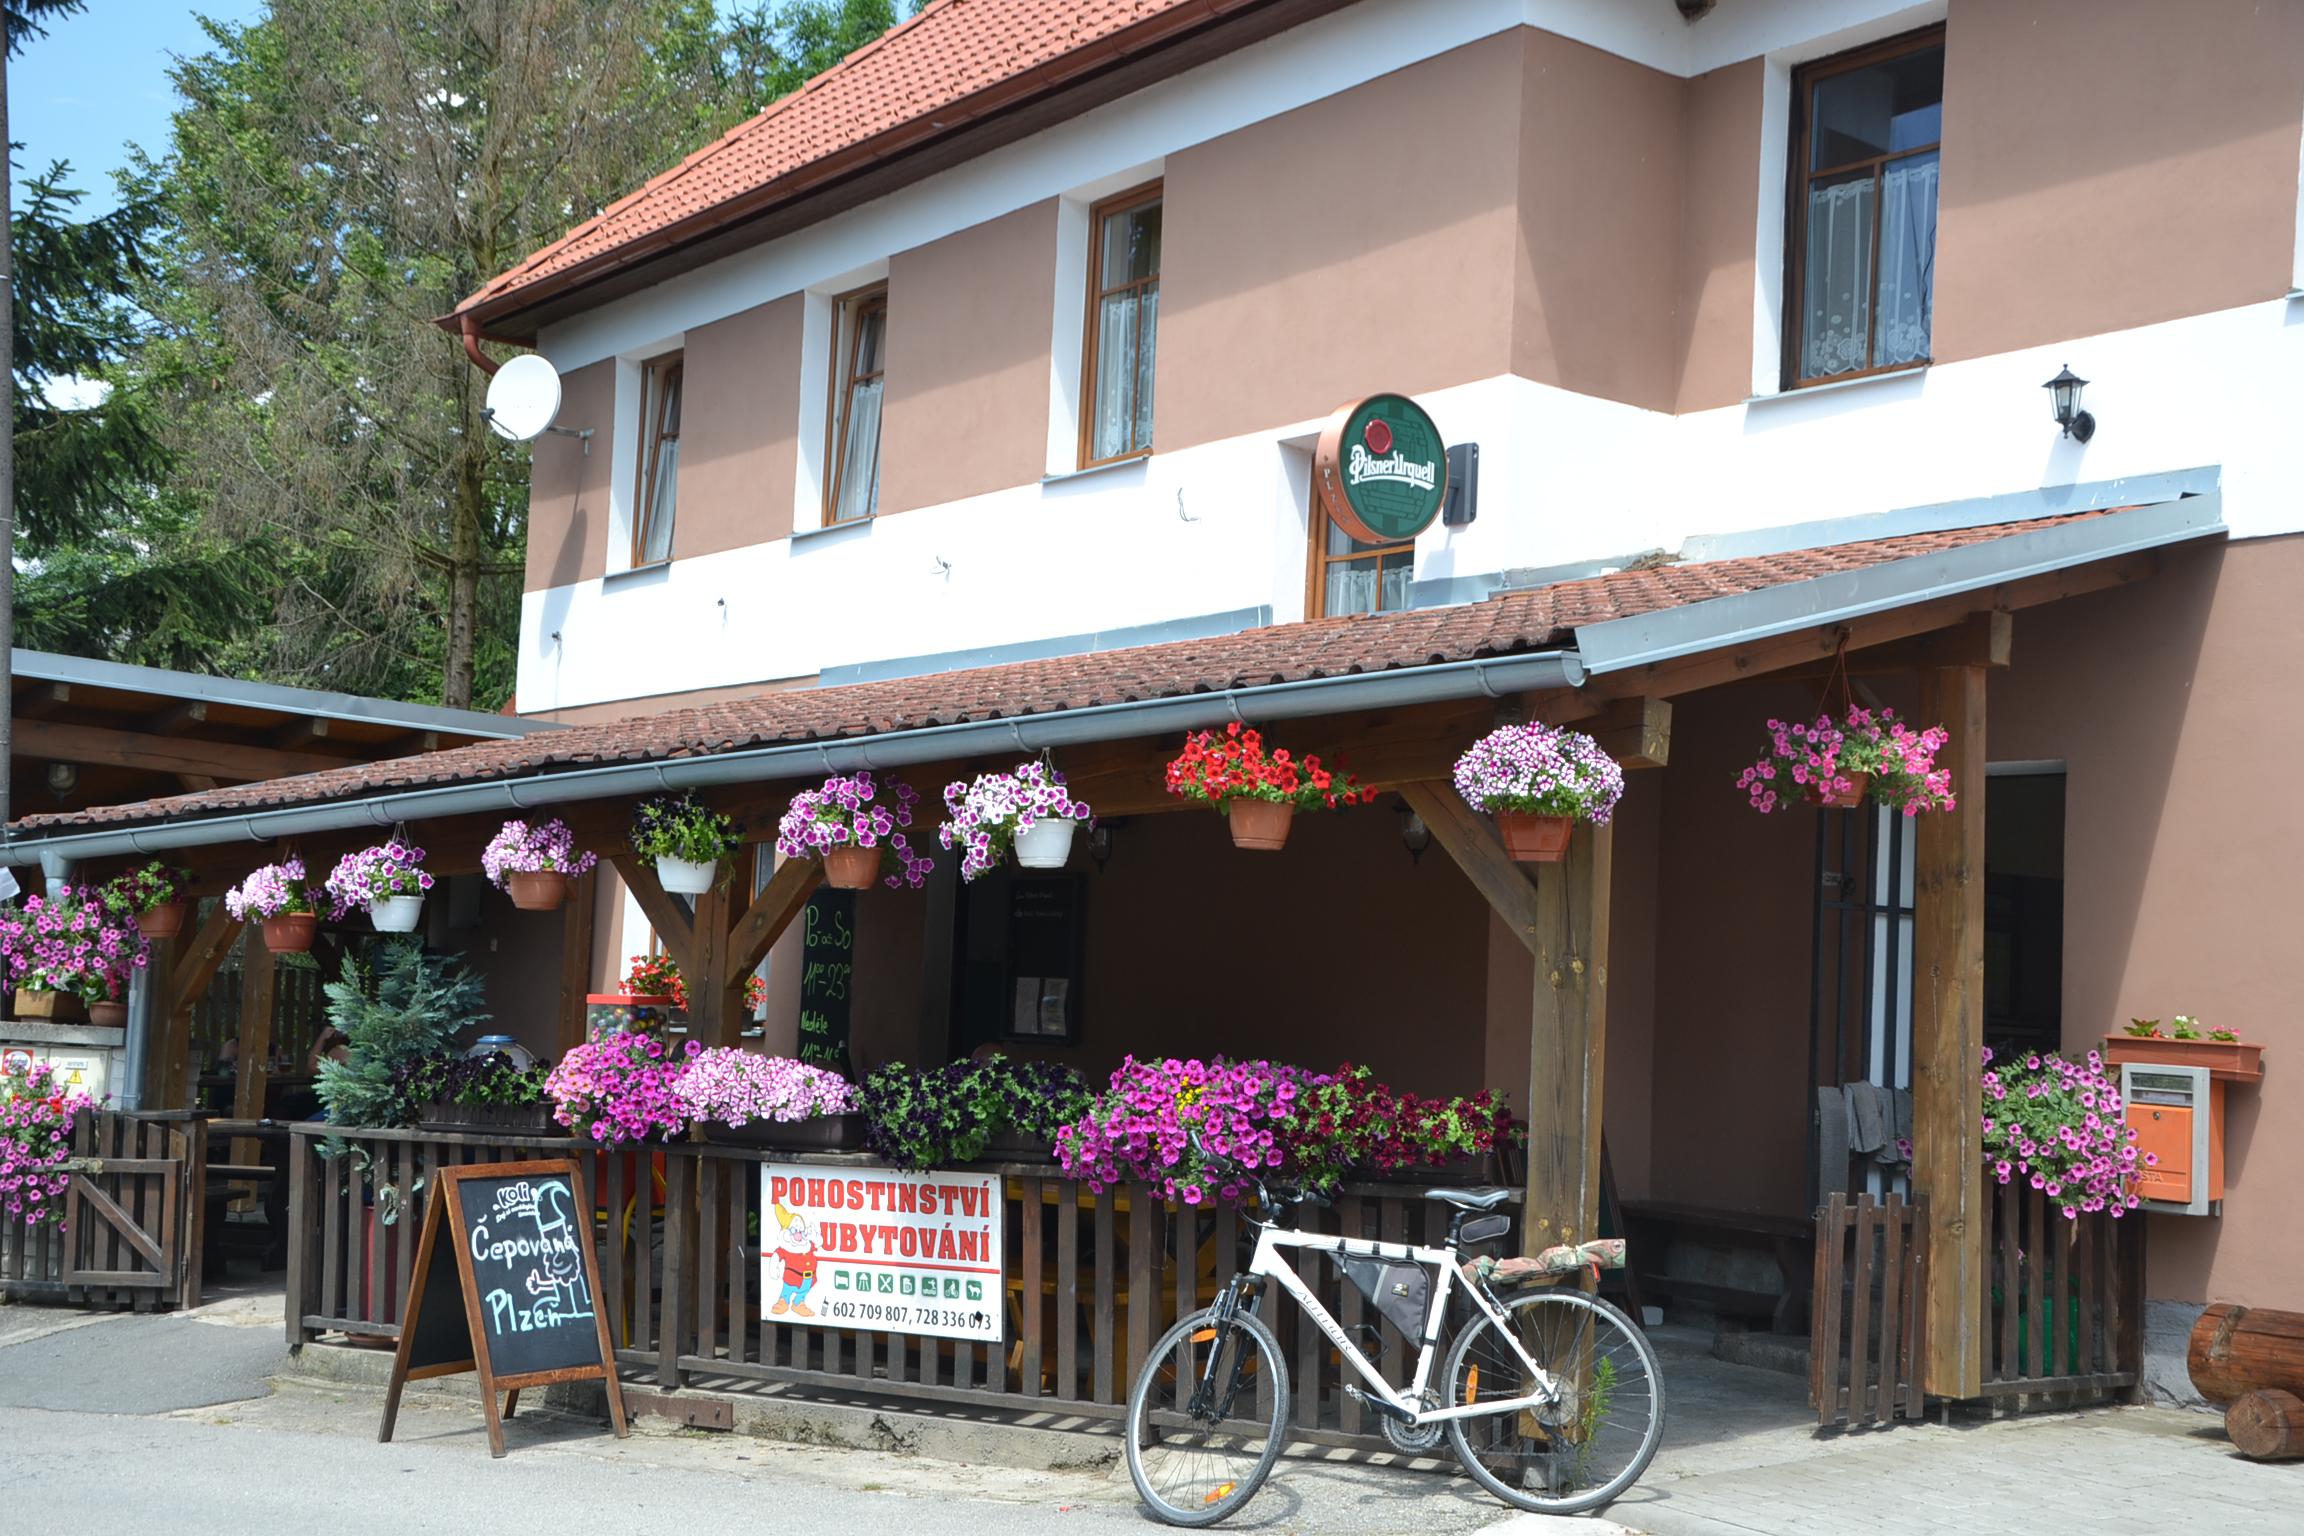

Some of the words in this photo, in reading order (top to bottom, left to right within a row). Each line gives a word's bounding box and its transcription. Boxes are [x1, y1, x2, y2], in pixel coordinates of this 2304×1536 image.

[1349, 443, 1395, 485] Pilsner
[1393, 450, 1435, 488] Urquell
[806, 904, 819, 947] Po
[834, 910, 852, 950] So
[770, 1175, 990, 1218] POHOSTINSTVÍ
[471, 1214, 579, 1270] Čepovaná
[819, 1221, 990, 1263] UBYTOVÁNÍ
[485, 1287, 562, 1336] Plzeň
[833, 1302, 855, 1318] 602
[859, 1304, 882, 1320] 709
[885, 1306, 912, 1326] 807,
[916, 1308, 939, 1326] 728
[942, 1310, 965, 1328] 336
